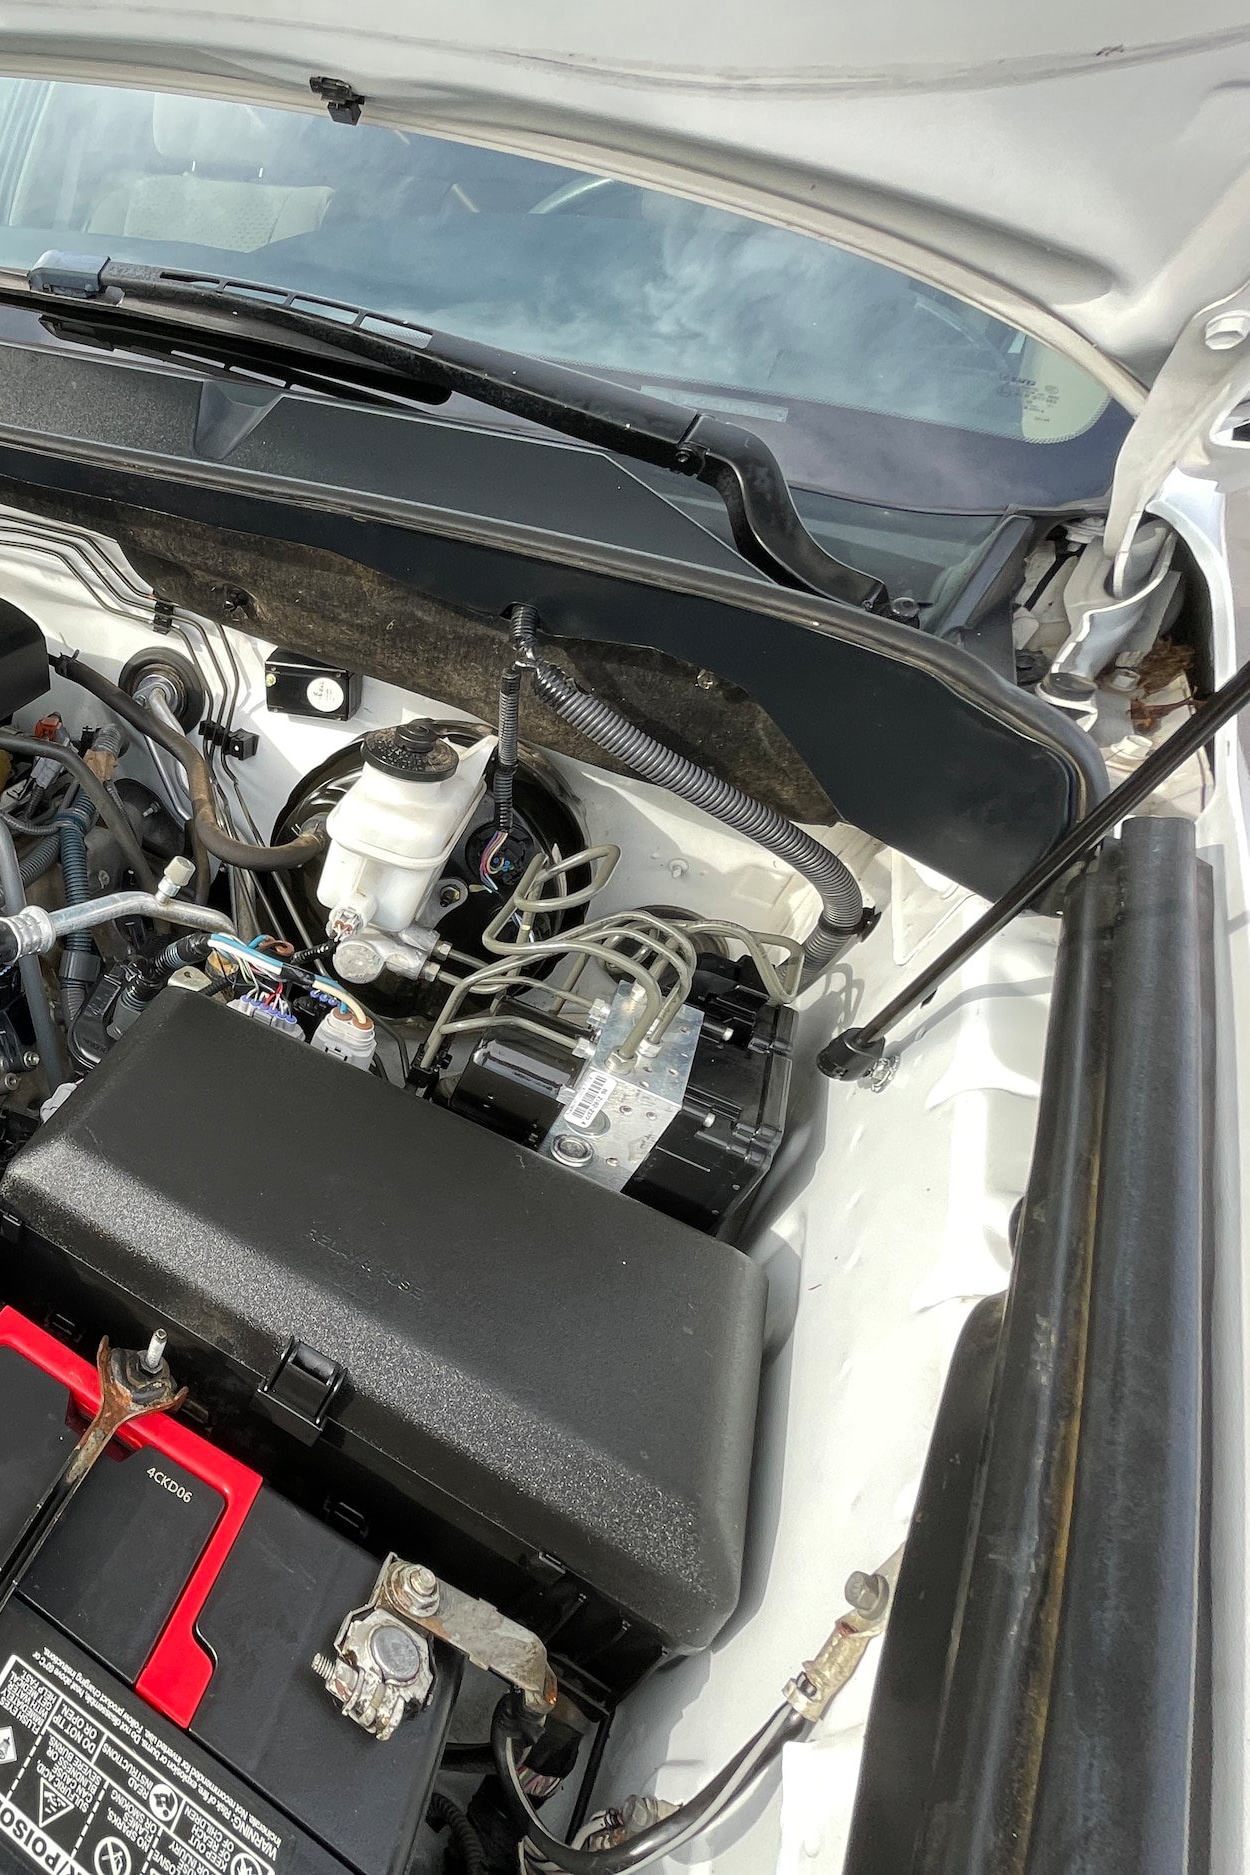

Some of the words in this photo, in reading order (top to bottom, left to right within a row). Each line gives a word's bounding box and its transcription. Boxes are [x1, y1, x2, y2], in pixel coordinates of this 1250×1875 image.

[146, 1467, 192, 1502] 4CKD06
[31, 1650, 41, 1660] or
[43, 1646, 77, 1679] instructions.
[9, 1670, 39, 1700] MEDICAL
[20, 1669, 39, 1689] FAST.
[53, 1667, 72, 1685] above
[74, 1671, 101, 1697] charging
[6, 1679, 31, 1705] WATER.
[37, 1685, 57, 1704] HELP
[69, 1680, 87, 1698] heat
[0, 1687, 44, 1729] IMMEDIATELY
[25, 1698, 48, 1721] WITH
[35, 1694, 52, 1710] GET
[98, 1693, 125, 1716] product
[12, 1709, 40, 1735] FLUSH
[49, 1713, 66, 1729] TIP
[60, 1703, 84, 1729] OPEN.
[118, 1720, 132, 1735] not
[121, 1711, 143, 1734] Follow
[63, 1721, 84, 1743] NOT
[82, 1722, 97, 1739] OR
[130, 1730, 143, 1744] Do
[45, 1745, 59, 1761] OR
[48, 1734, 74, 1761] BURNS.
[81, 1737, 99, 1754] DO
[140, 1737, 161, 1760] burns.
[155, 1739, 182, 1767] inverted
[36, 1759, 55, 1782] ACID,
[72, 1754, 101, 1787] SEVERE
[99, 1742, 153, 1793] INSTRUCTIONS
[158, 1754, 169, 1764] or
[176, 1759, 193, 1773] for
[51, 1762, 77, 1790] CAUSE
[57, 1755, 97, 1796] BLINDNESS
[166, 1756, 198, 1789] explosion
[52, 1777, 89, 1812] SULFURIC
[75, 1784, 94, 1804] CAN
[127, 1774, 152, 1800] READ
[189, 1767, 236, 1812] recommended
[194, 1782, 212, 1801] fire,
[110, 1786, 145, 1824] SMOKING
[206, 1794, 217, 1805] of
[215, 1799, 232, 1819] Risk
[232, 1803, 248, 1819] Not
[106, 1806, 137, 1841] SPARKS,
[122, 1809, 153, 1843] FLAMES
[141, 1817, 157, 1834] OR
[183, 1801, 222, 1843] CHILDREN
[135, 1835, 152, 1852] NO
[187, 1834, 206, 1853] OUT
[190, 1821, 219, 1853] REACH
[220, 1838, 234, 1853] OF
[230, 1809, 278, 1862] WARNING:
[168, 1840, 197, 1869] INJURY
[204, 1846, 227, 1872] KEEP
[217, 1847, 231, 1864] OF
